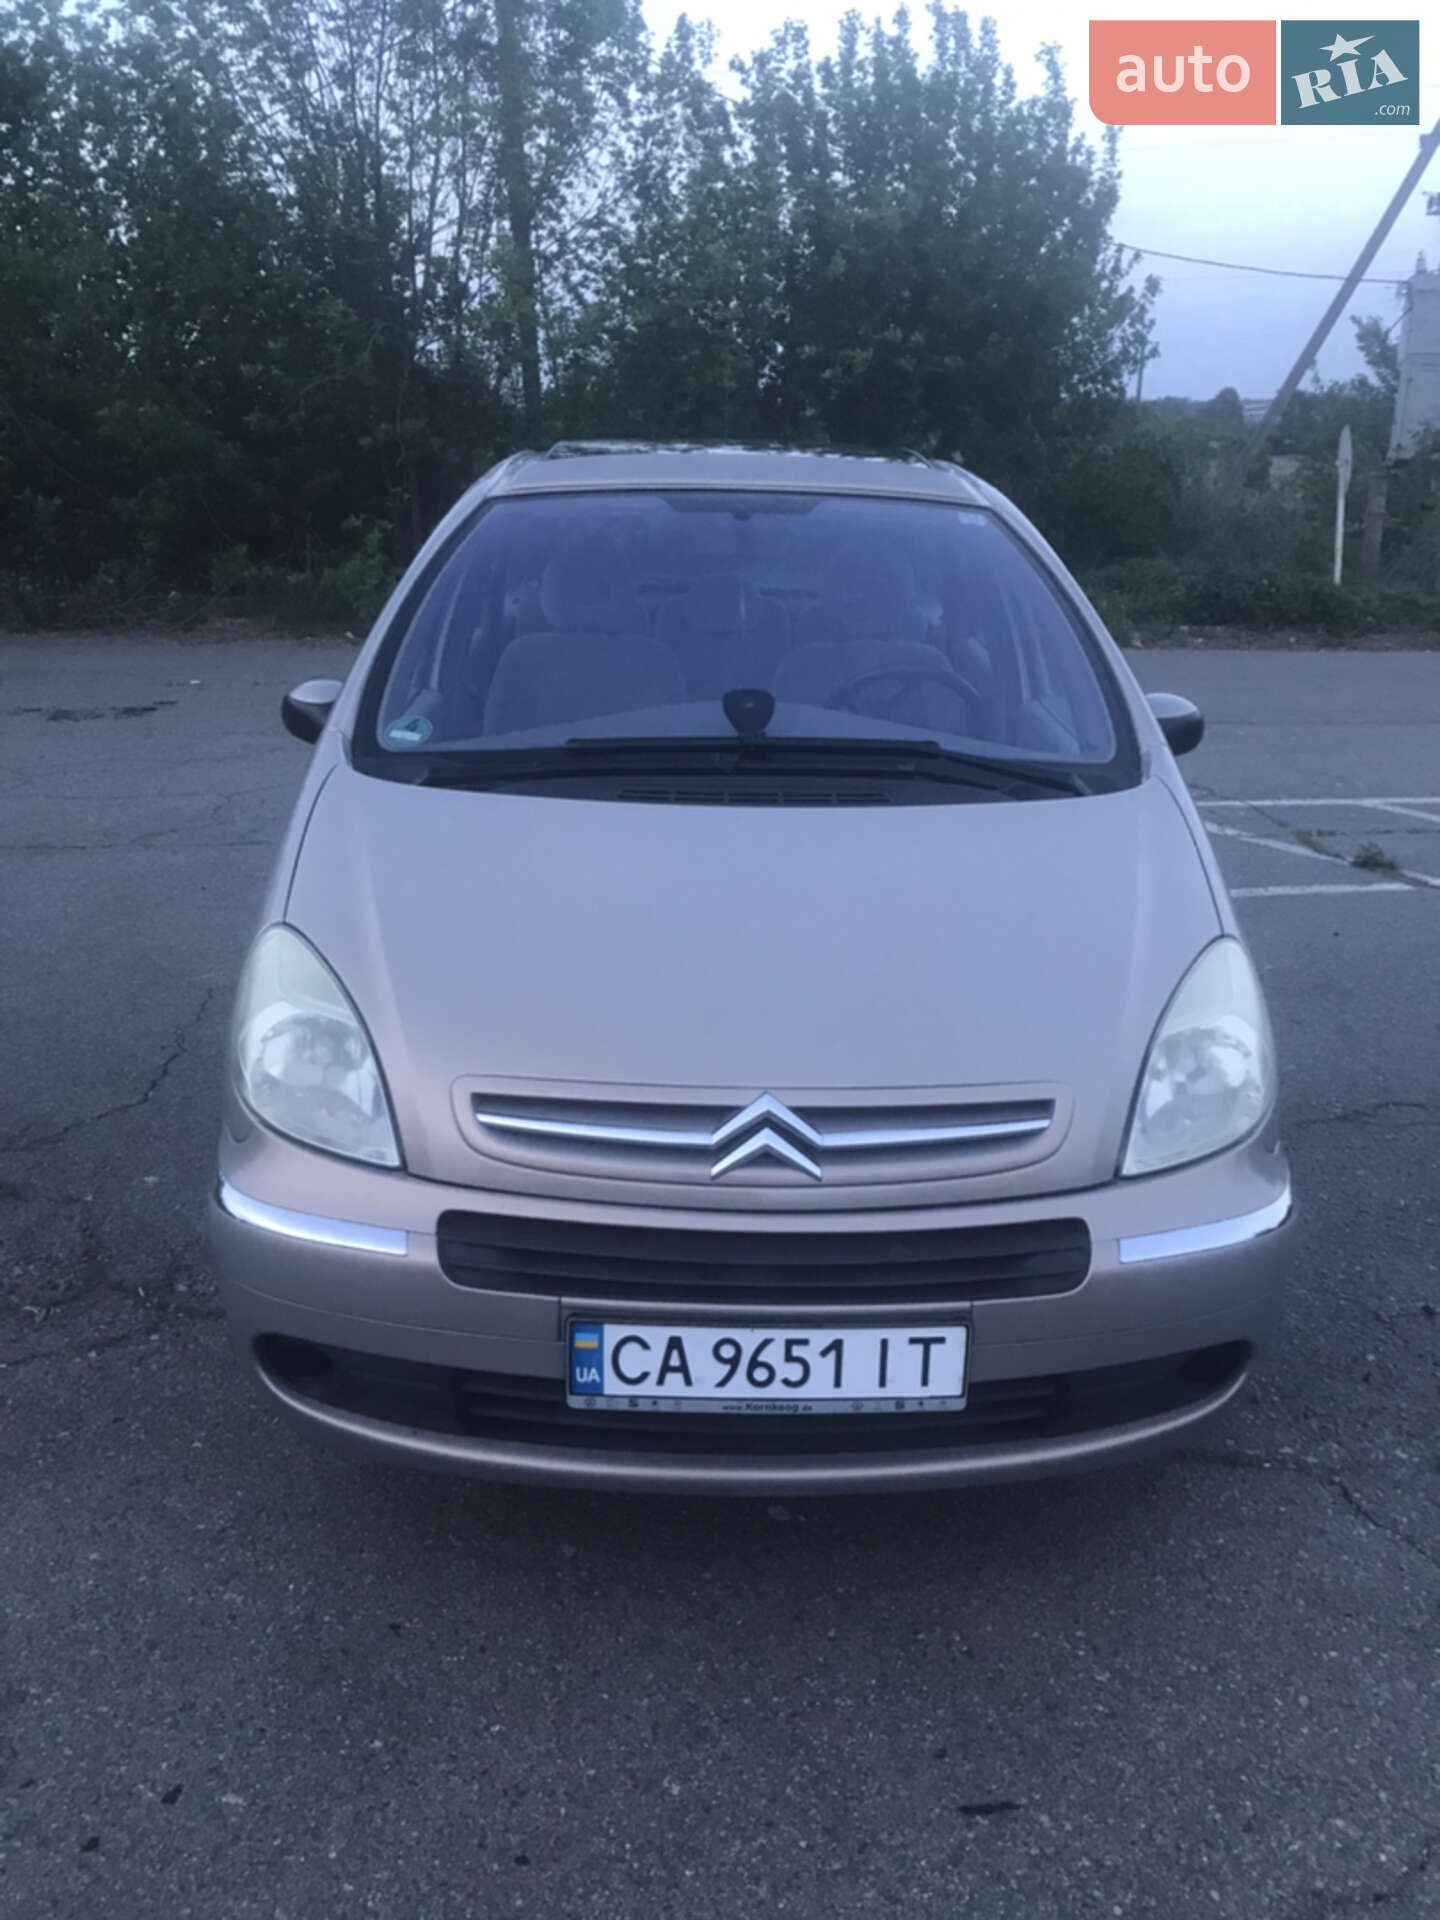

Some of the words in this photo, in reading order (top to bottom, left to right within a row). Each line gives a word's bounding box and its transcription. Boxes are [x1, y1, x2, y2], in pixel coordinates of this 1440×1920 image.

[575, 1367, 600, 1384] UA
[611, 1335, 693, 1387] CA
[712, 1337, 844, 1389] 9651
[878, 1338, 946, 1388] IT
